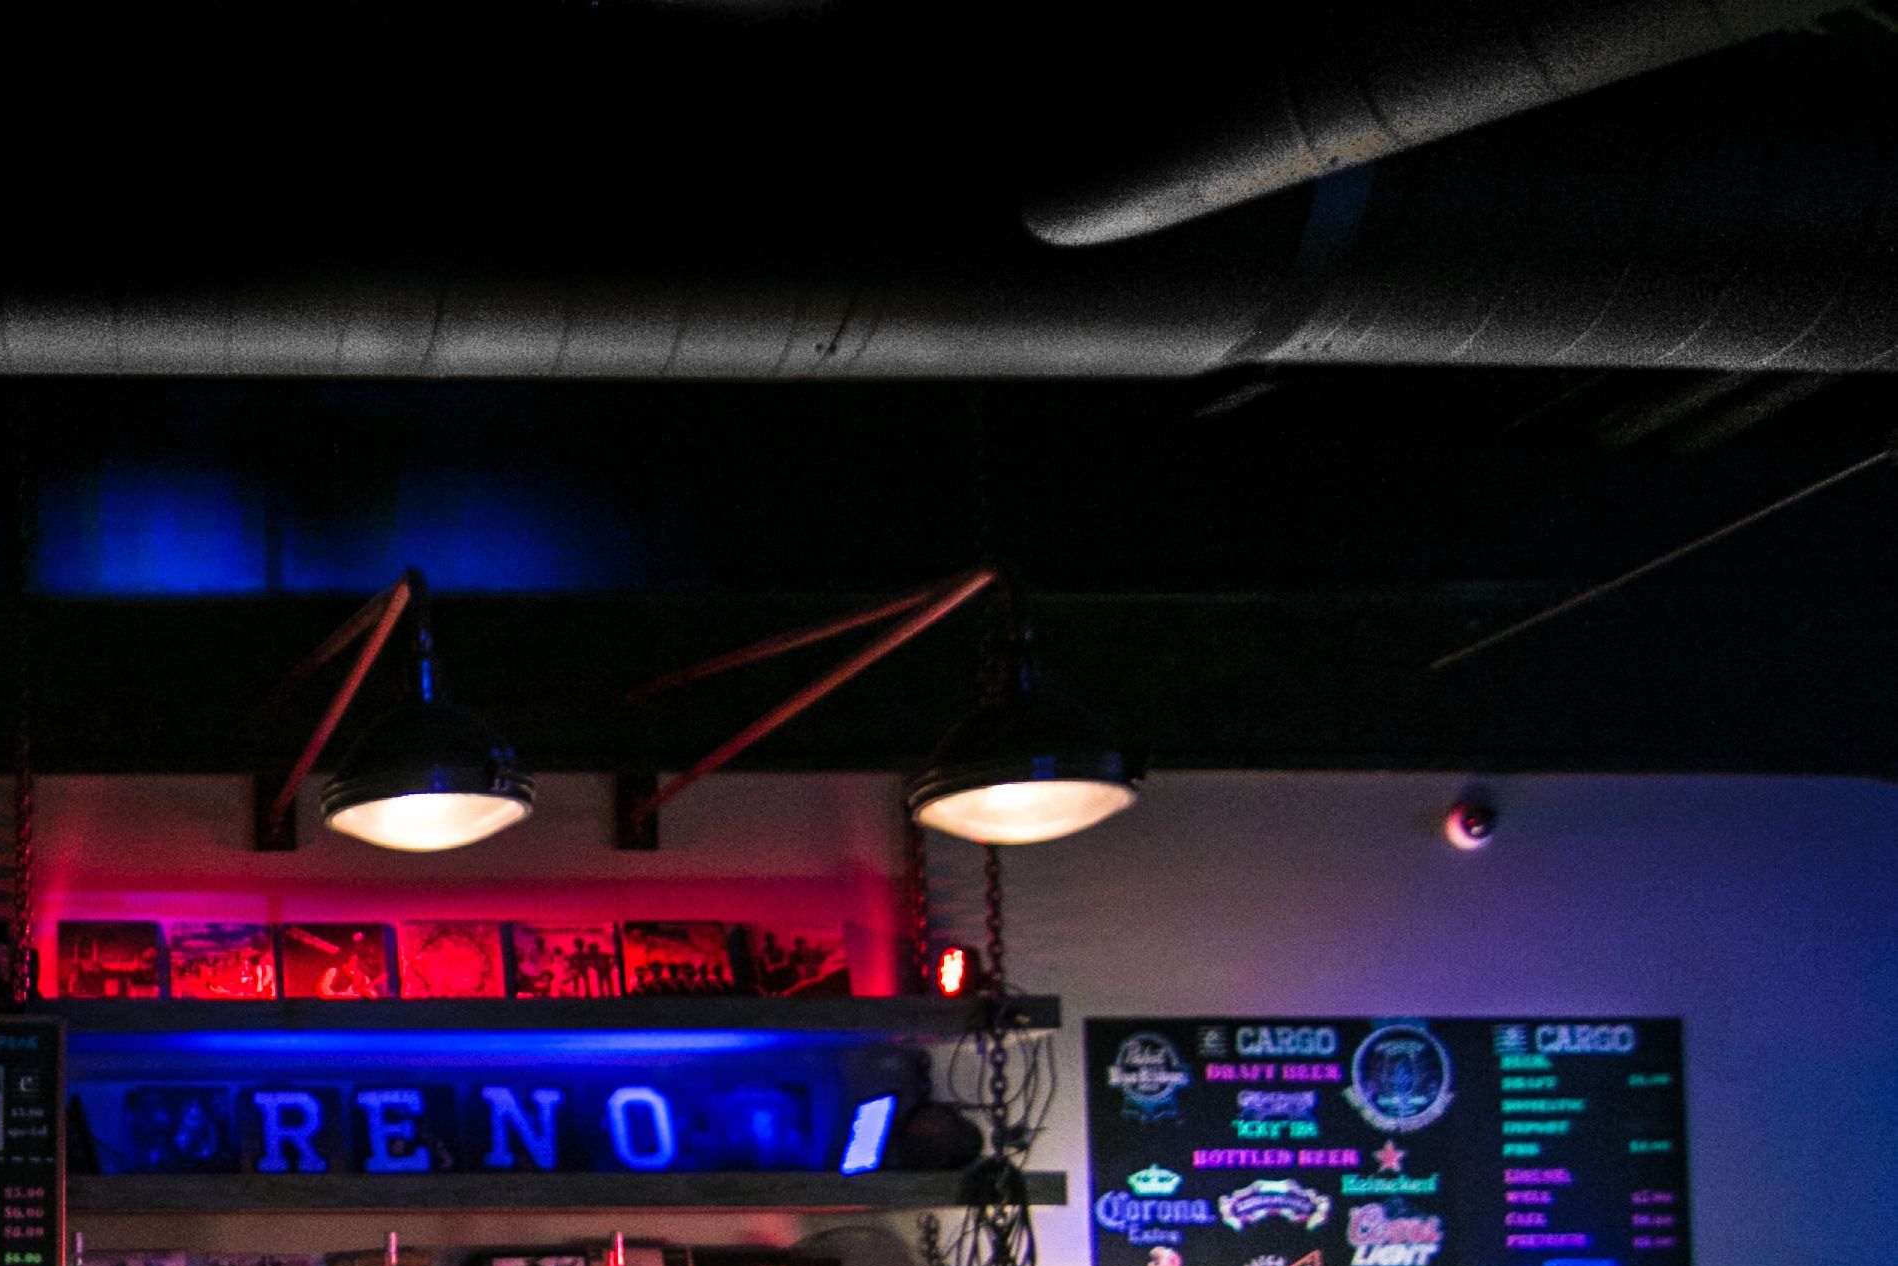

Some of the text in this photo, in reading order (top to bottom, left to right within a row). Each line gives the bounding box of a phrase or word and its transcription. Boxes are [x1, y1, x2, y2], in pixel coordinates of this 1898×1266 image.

[1236, 1027, 1337, 1056] CARGO
[1536, 1025, 1635, 1054] CARGO
[1205, 1063, 1343, 1081] DRAFT BEER
[253, 1086, 677, 1174] RENO
[1193, 1149, 1360, 1168] BOTTLED BEER
[1095, 1190, 1217, 1230] Corona
